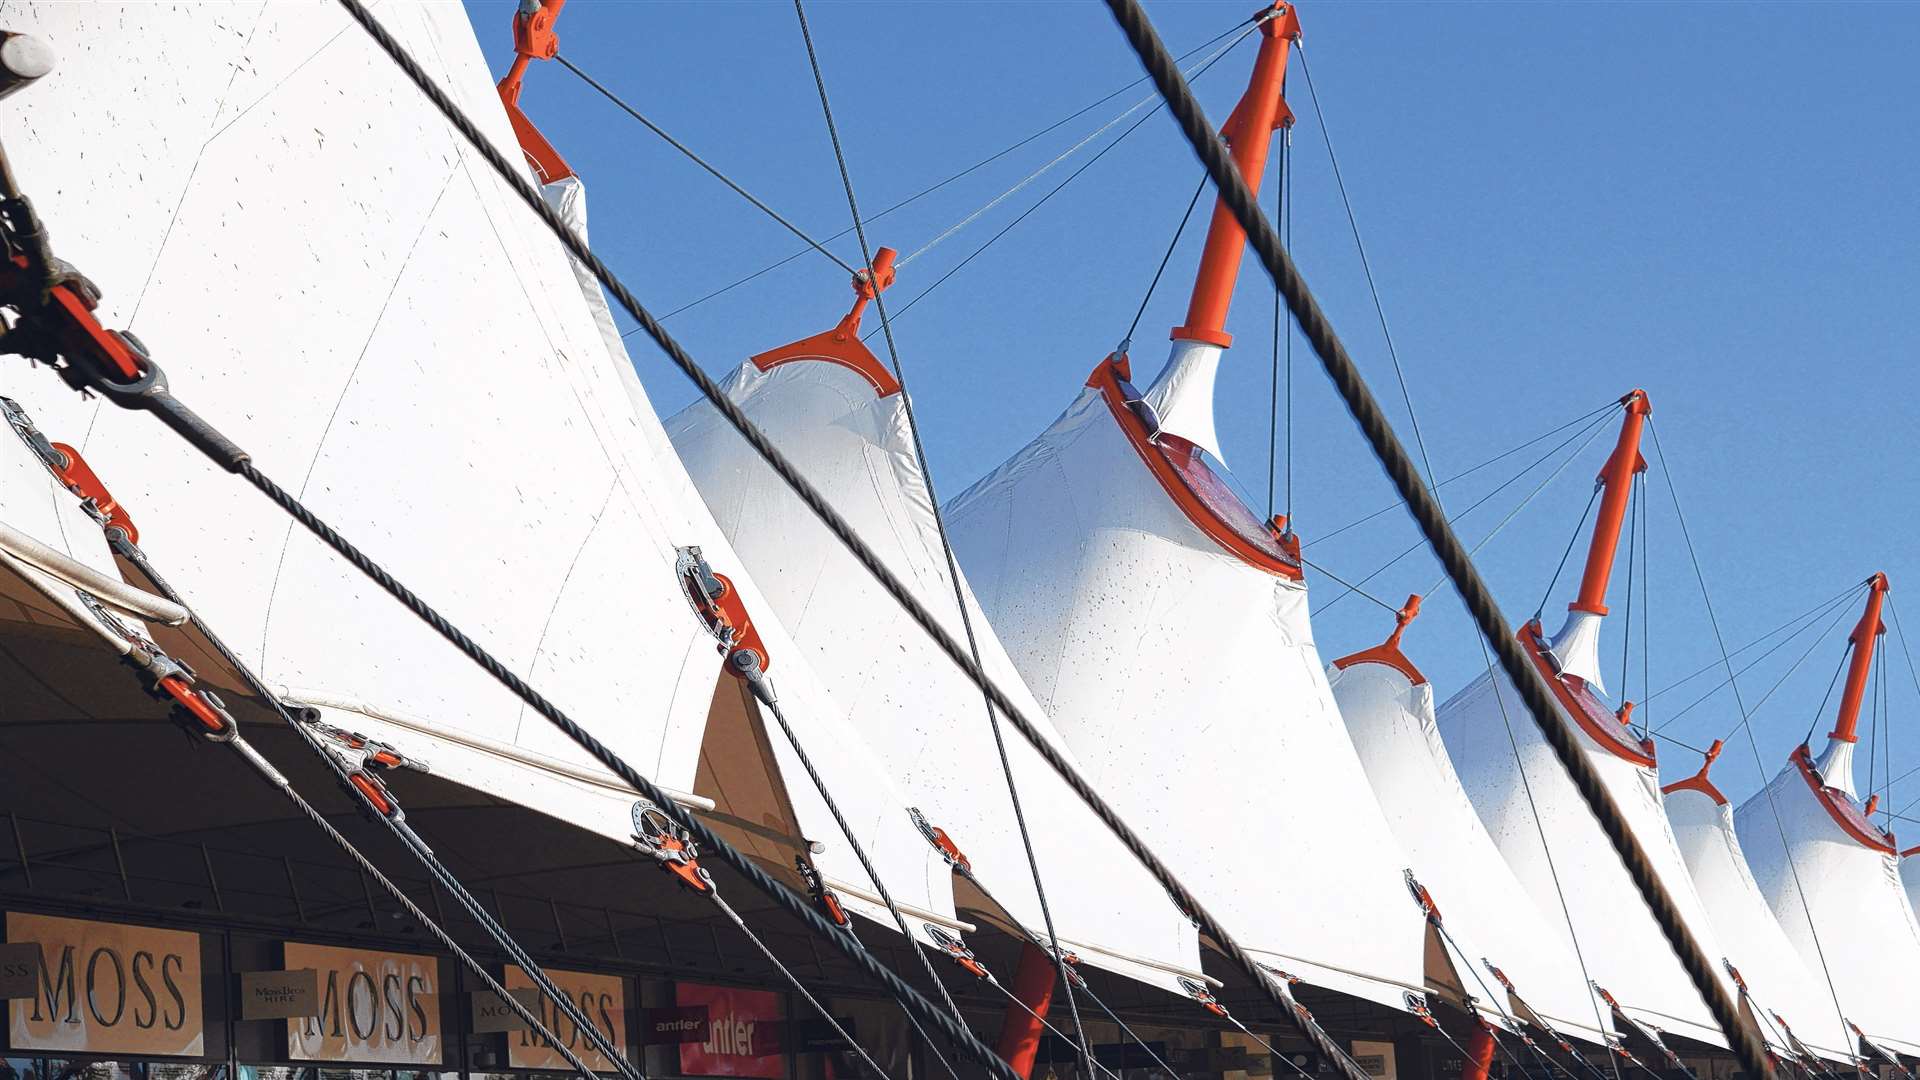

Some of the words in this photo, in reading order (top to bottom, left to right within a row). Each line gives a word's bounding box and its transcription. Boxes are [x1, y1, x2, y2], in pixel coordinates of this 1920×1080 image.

[30, 945, 186, 1030] MOSS
[304, 969, 428, 1042] MOSS
[656, 1018, 701, 1032] antler
